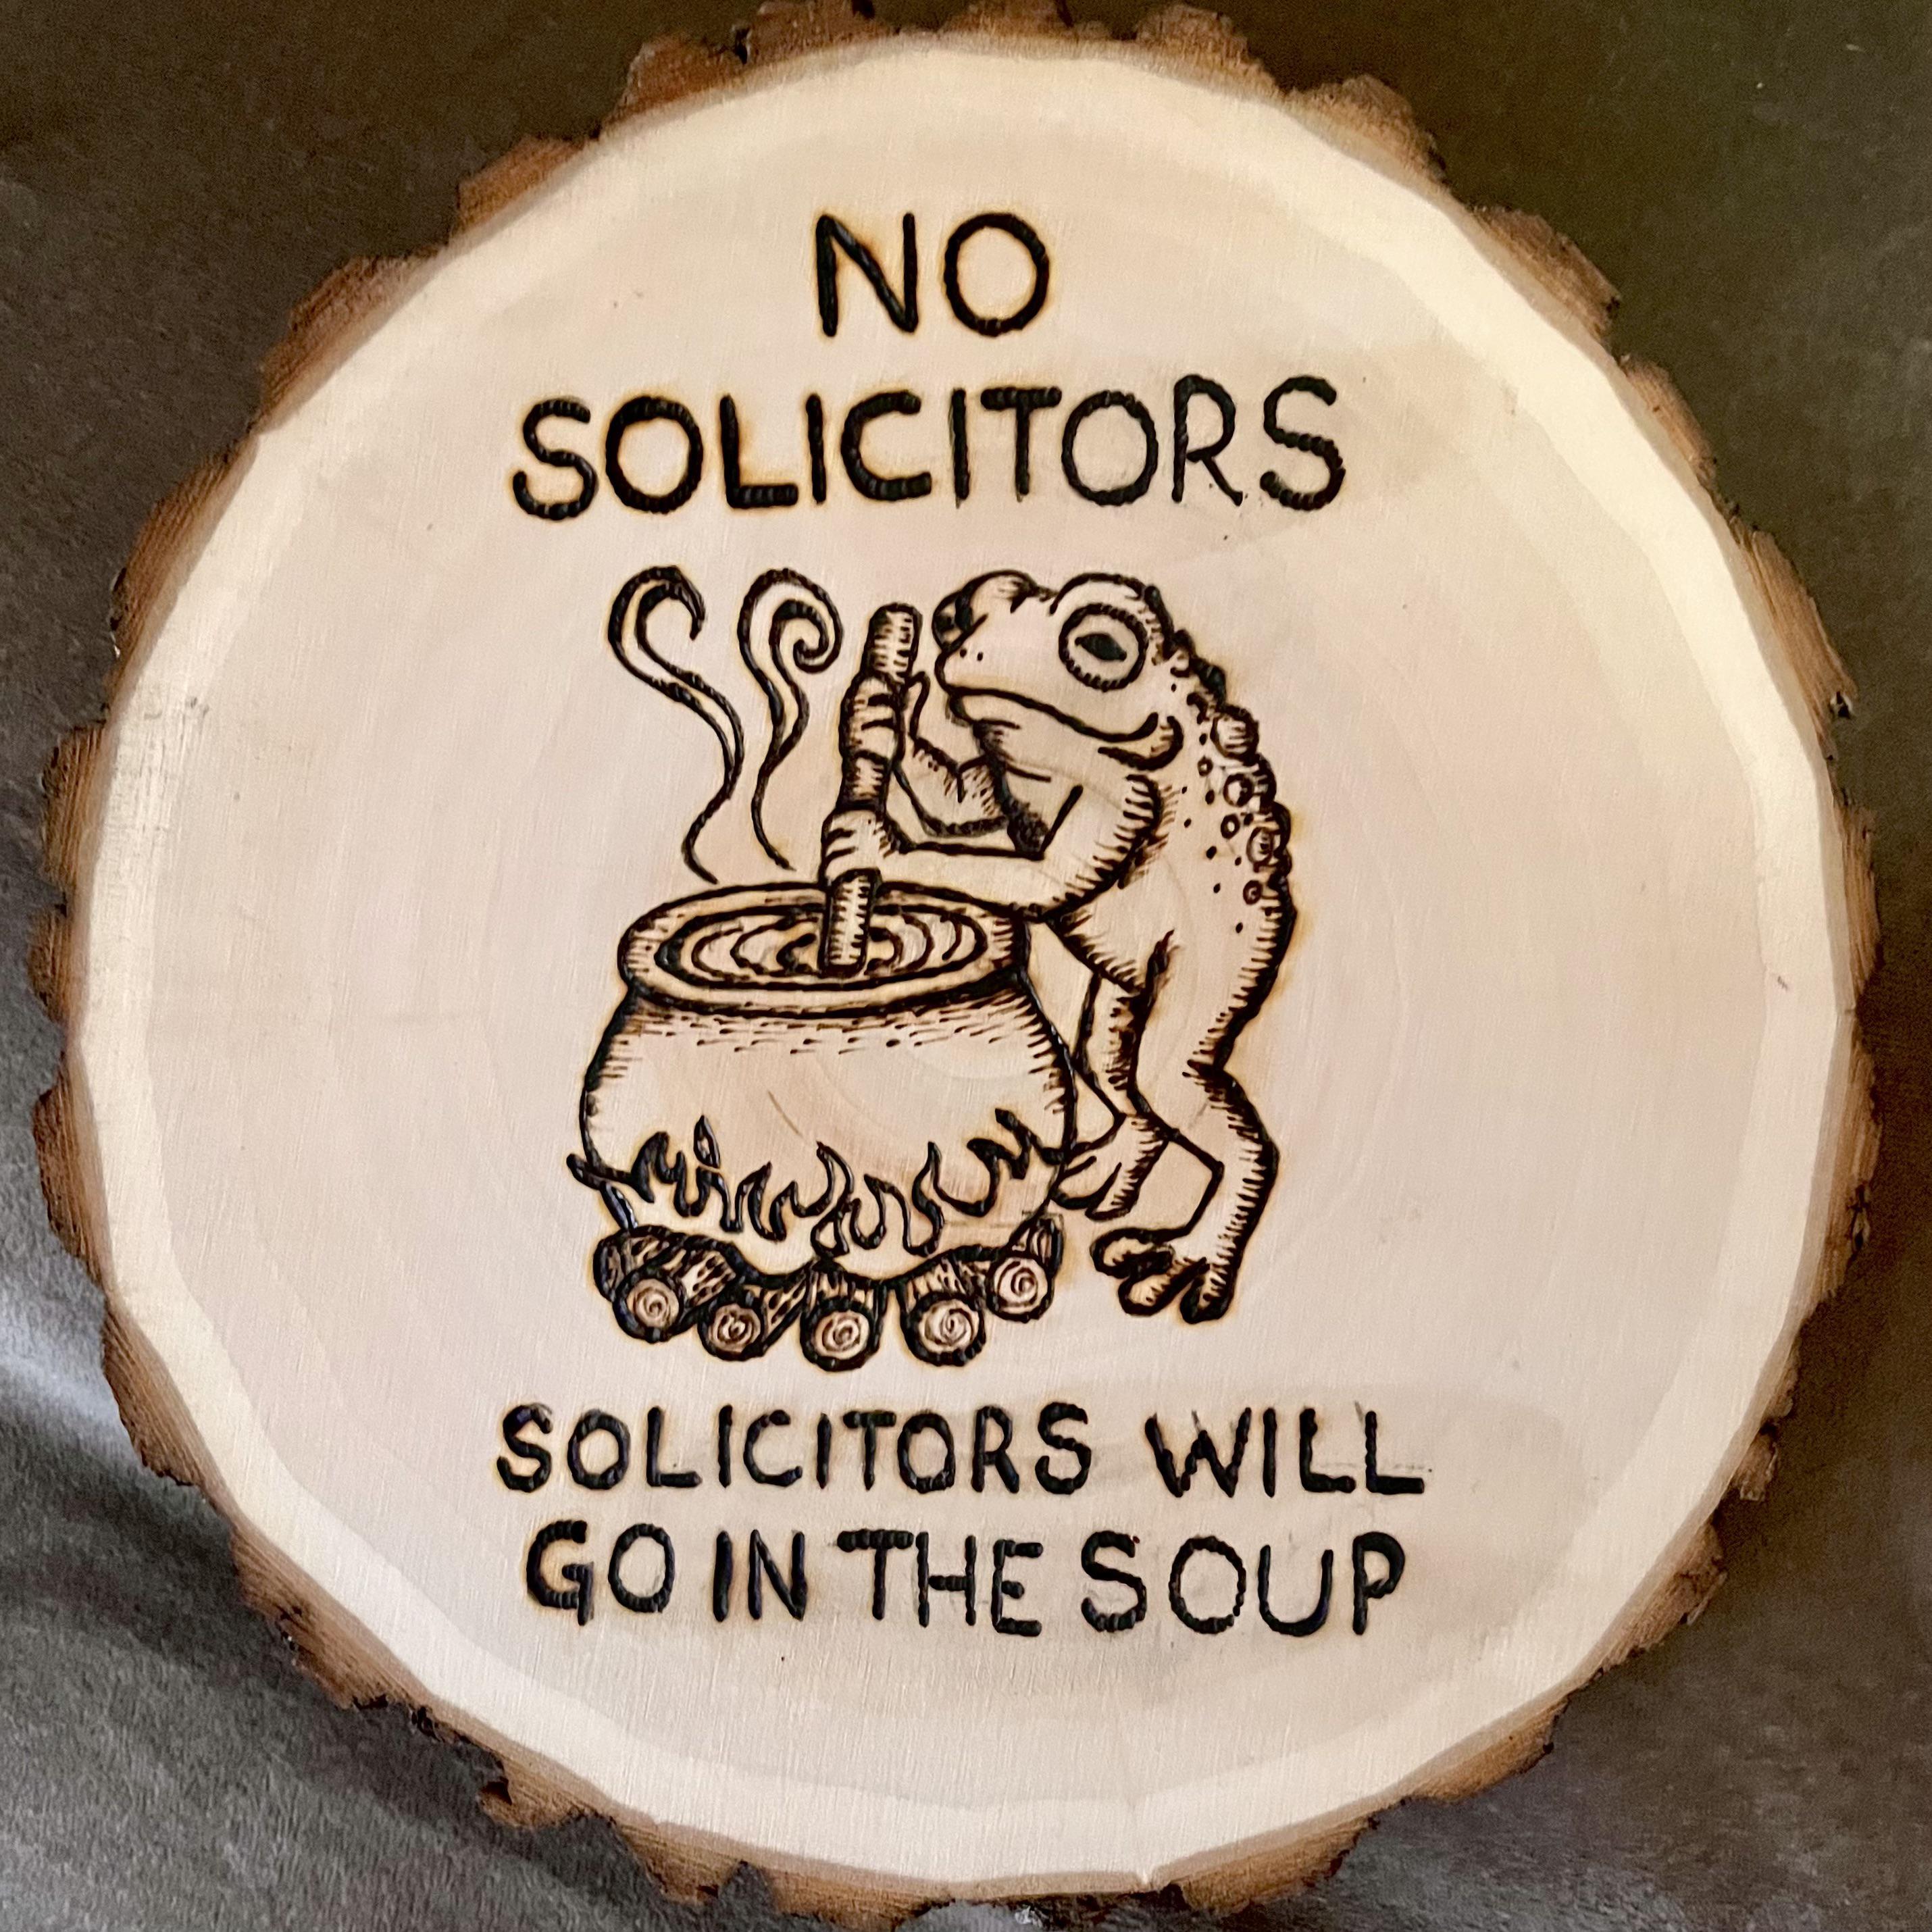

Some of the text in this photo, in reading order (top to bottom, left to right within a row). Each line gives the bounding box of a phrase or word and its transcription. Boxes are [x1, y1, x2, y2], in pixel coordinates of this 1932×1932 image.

[815, 213, 1050, 338] NO
[512, 374, 1346, 522] SOLICITORS
[497, 1402, 1425, 1498] SOLICITORS WILL
[526, 1520, 1406, 1638] GO IN THE SOUP
